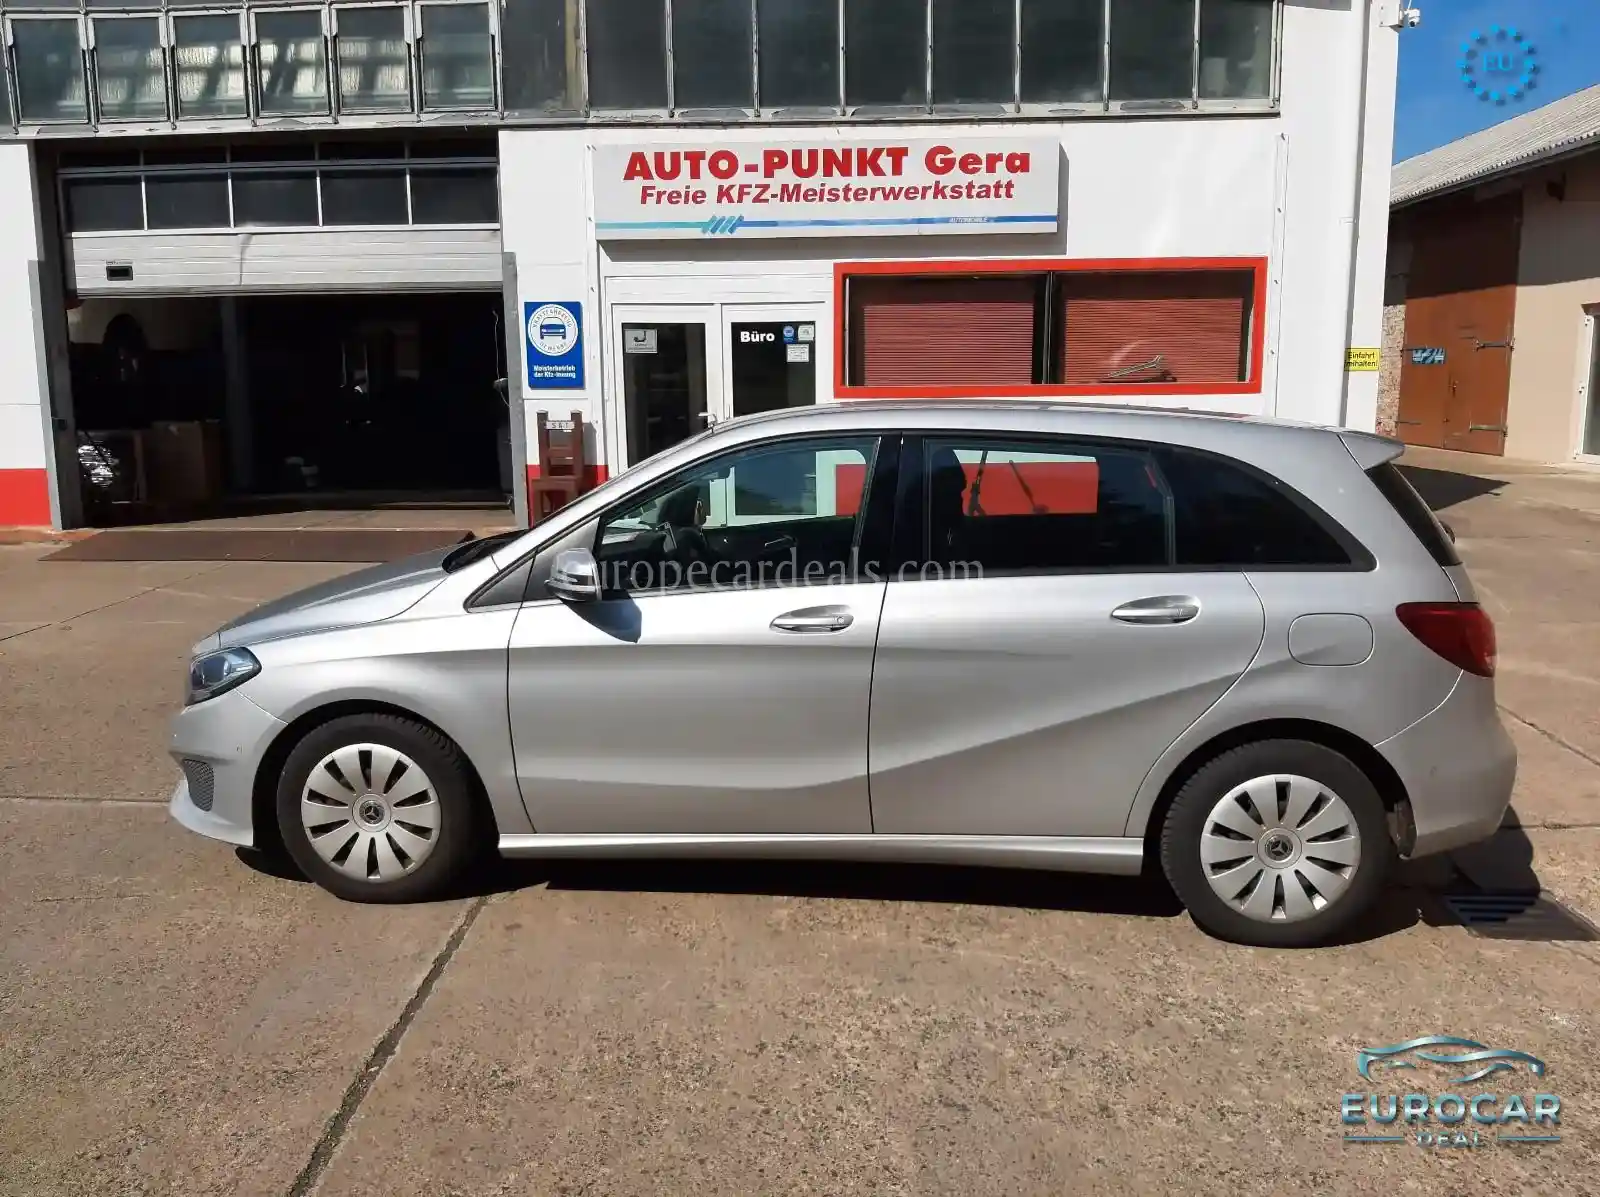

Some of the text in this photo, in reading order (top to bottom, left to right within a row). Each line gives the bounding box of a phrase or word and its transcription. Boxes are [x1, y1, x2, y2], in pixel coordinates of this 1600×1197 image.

[623, 145, 1031, 181] AUTO-PUNKT Gera
[640, 180, 1015, 205] Freie KFZ-Meisterwerkstatt
[740, 330, 775, 342] Büro
